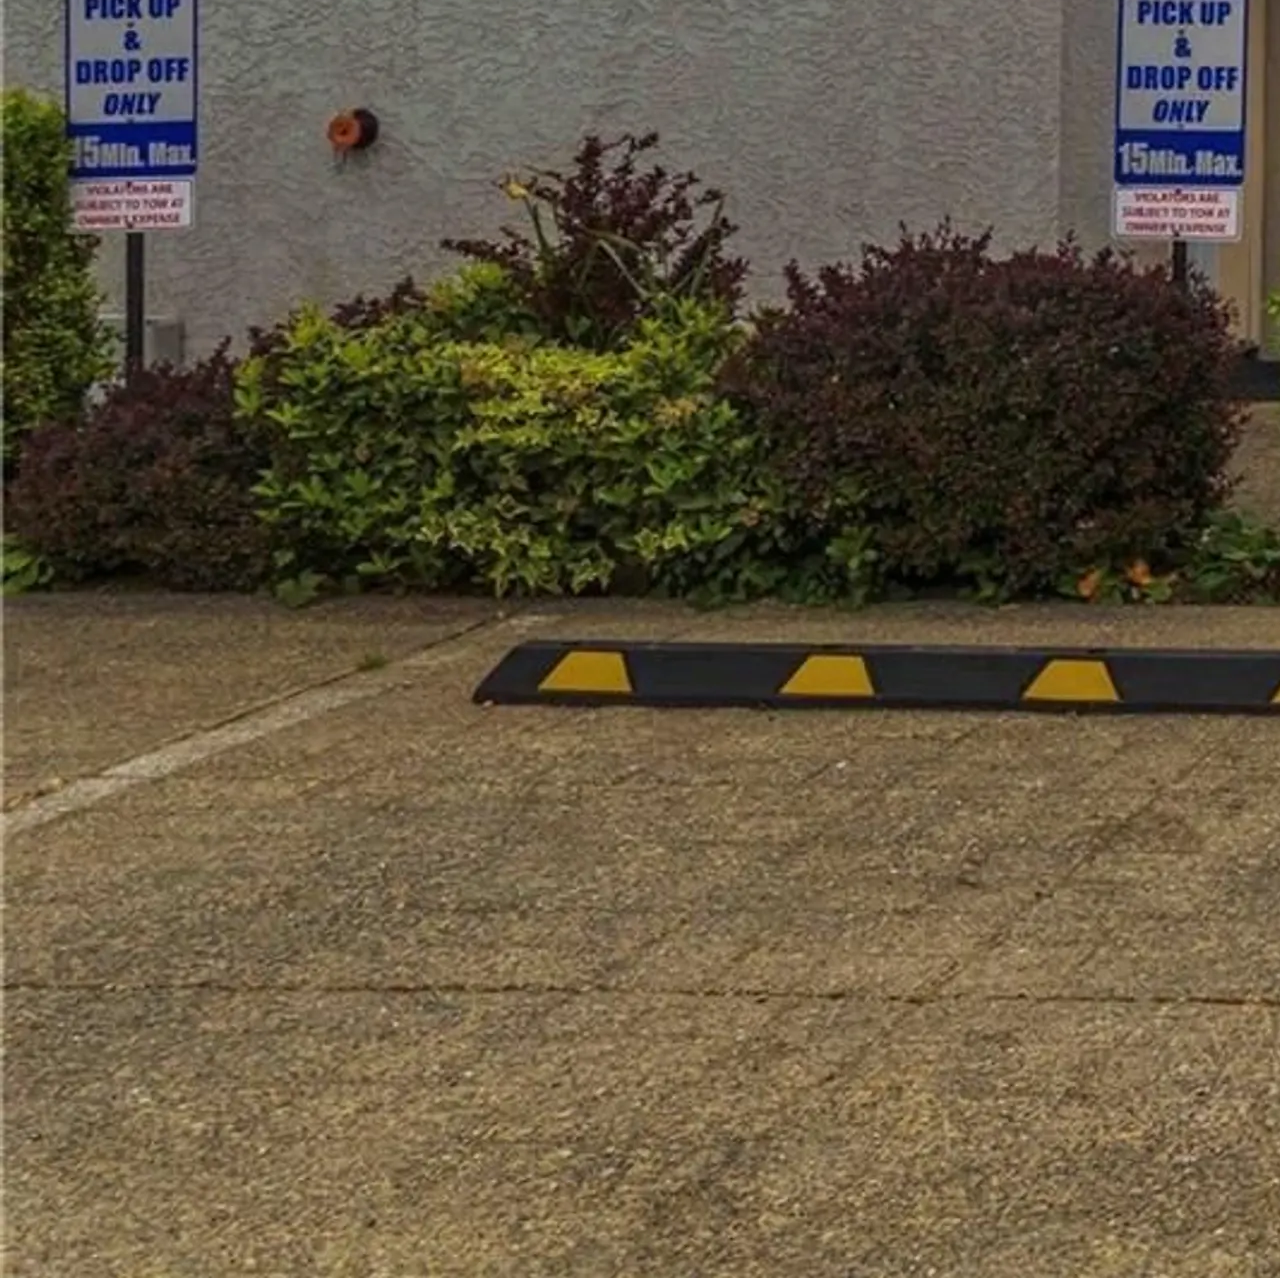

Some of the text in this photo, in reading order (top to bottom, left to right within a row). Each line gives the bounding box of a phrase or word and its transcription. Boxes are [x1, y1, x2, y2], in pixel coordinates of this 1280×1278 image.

[1137, 0, 1232, 26] PICK UP
[124, 30, 142, 51] &
[1174, 37, 1192, 58] &
[75, 58, 189, 85] DROP OFF
[1126, 65, 1239, 91] DROP OFF
[104, 92, 161, 116] ONLY
[1152, 99, 1211, 123] ONLY
[1196, 150, 1243, 177] Max.
